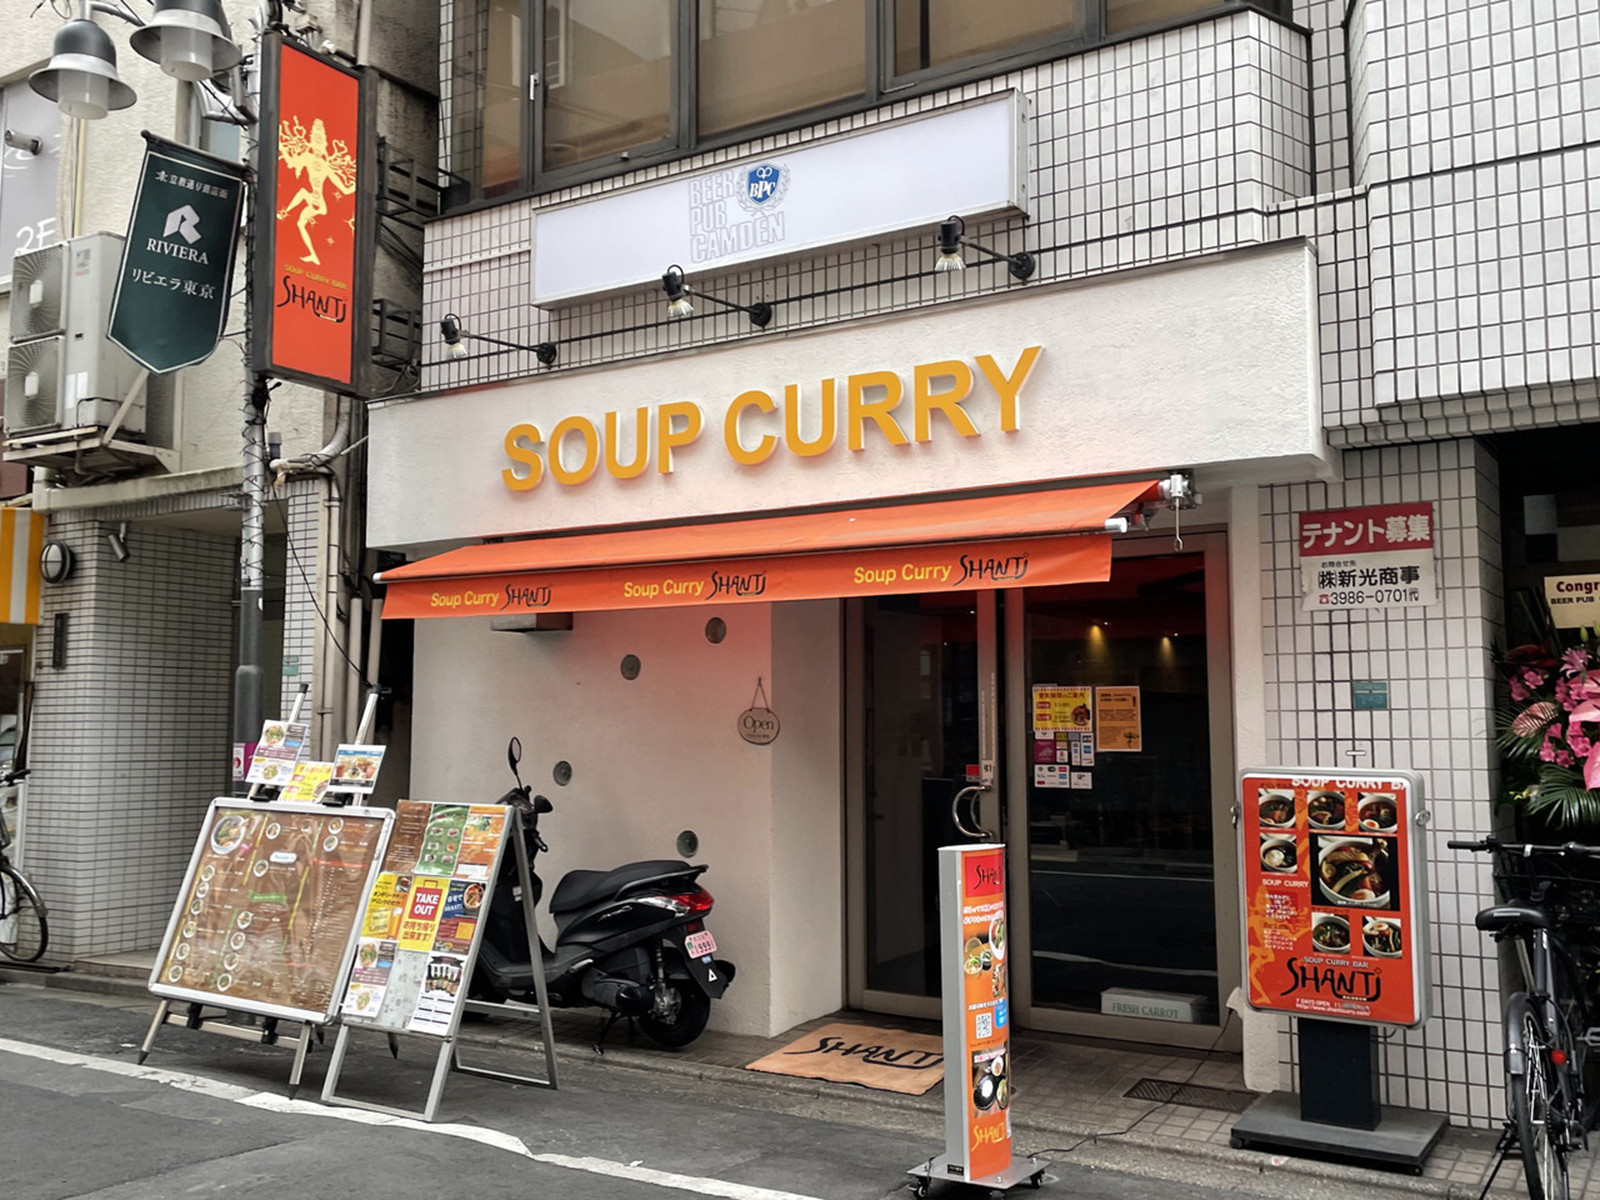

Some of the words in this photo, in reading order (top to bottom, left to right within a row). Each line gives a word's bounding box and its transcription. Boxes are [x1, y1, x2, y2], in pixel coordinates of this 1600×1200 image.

[688, 170, 736, 209] BEER
[749, 180, 776, 199] BPC
[690, 199, 727, 236] PUB
[690, 211, 786, 263] CAMDEN
[146, 238, 209, 265] RIVIERA
[132, 268, 216, 299] リビエラ東京
[502, 400, 704, 492] SOUP
[724, 345, 1046, 466] CURRY
[1301, 513, 1431, 549] テナント募集
[853, 566, 897, 586] Soup
[901, 563, 952, 583] Curry
[430, 592, 462, 609] Soup
[464, 589, 499, 607] Curry
[624, 581, 660, 599] Soup
[662, 579, 705, 597] Curry
[1550, 596, 1575, 605] BEER
[1576, 595, 1595, 604] PUB
[743, 715, 774, 733] Open
[1262, 878, 1282, 886] SOUP
[1284, 879, 1310, 888] CURRY
[415, 893, 439, 905] TAKE
[413, 904, 434, 916] OUT
[1303, 956, 1324, 964] SOUP
[1325, 958, 1350, 967] CURRY
[1112, 1002, 1140, 1014] FRESH
[1141, 1005, 1179, 1018] CARROT
